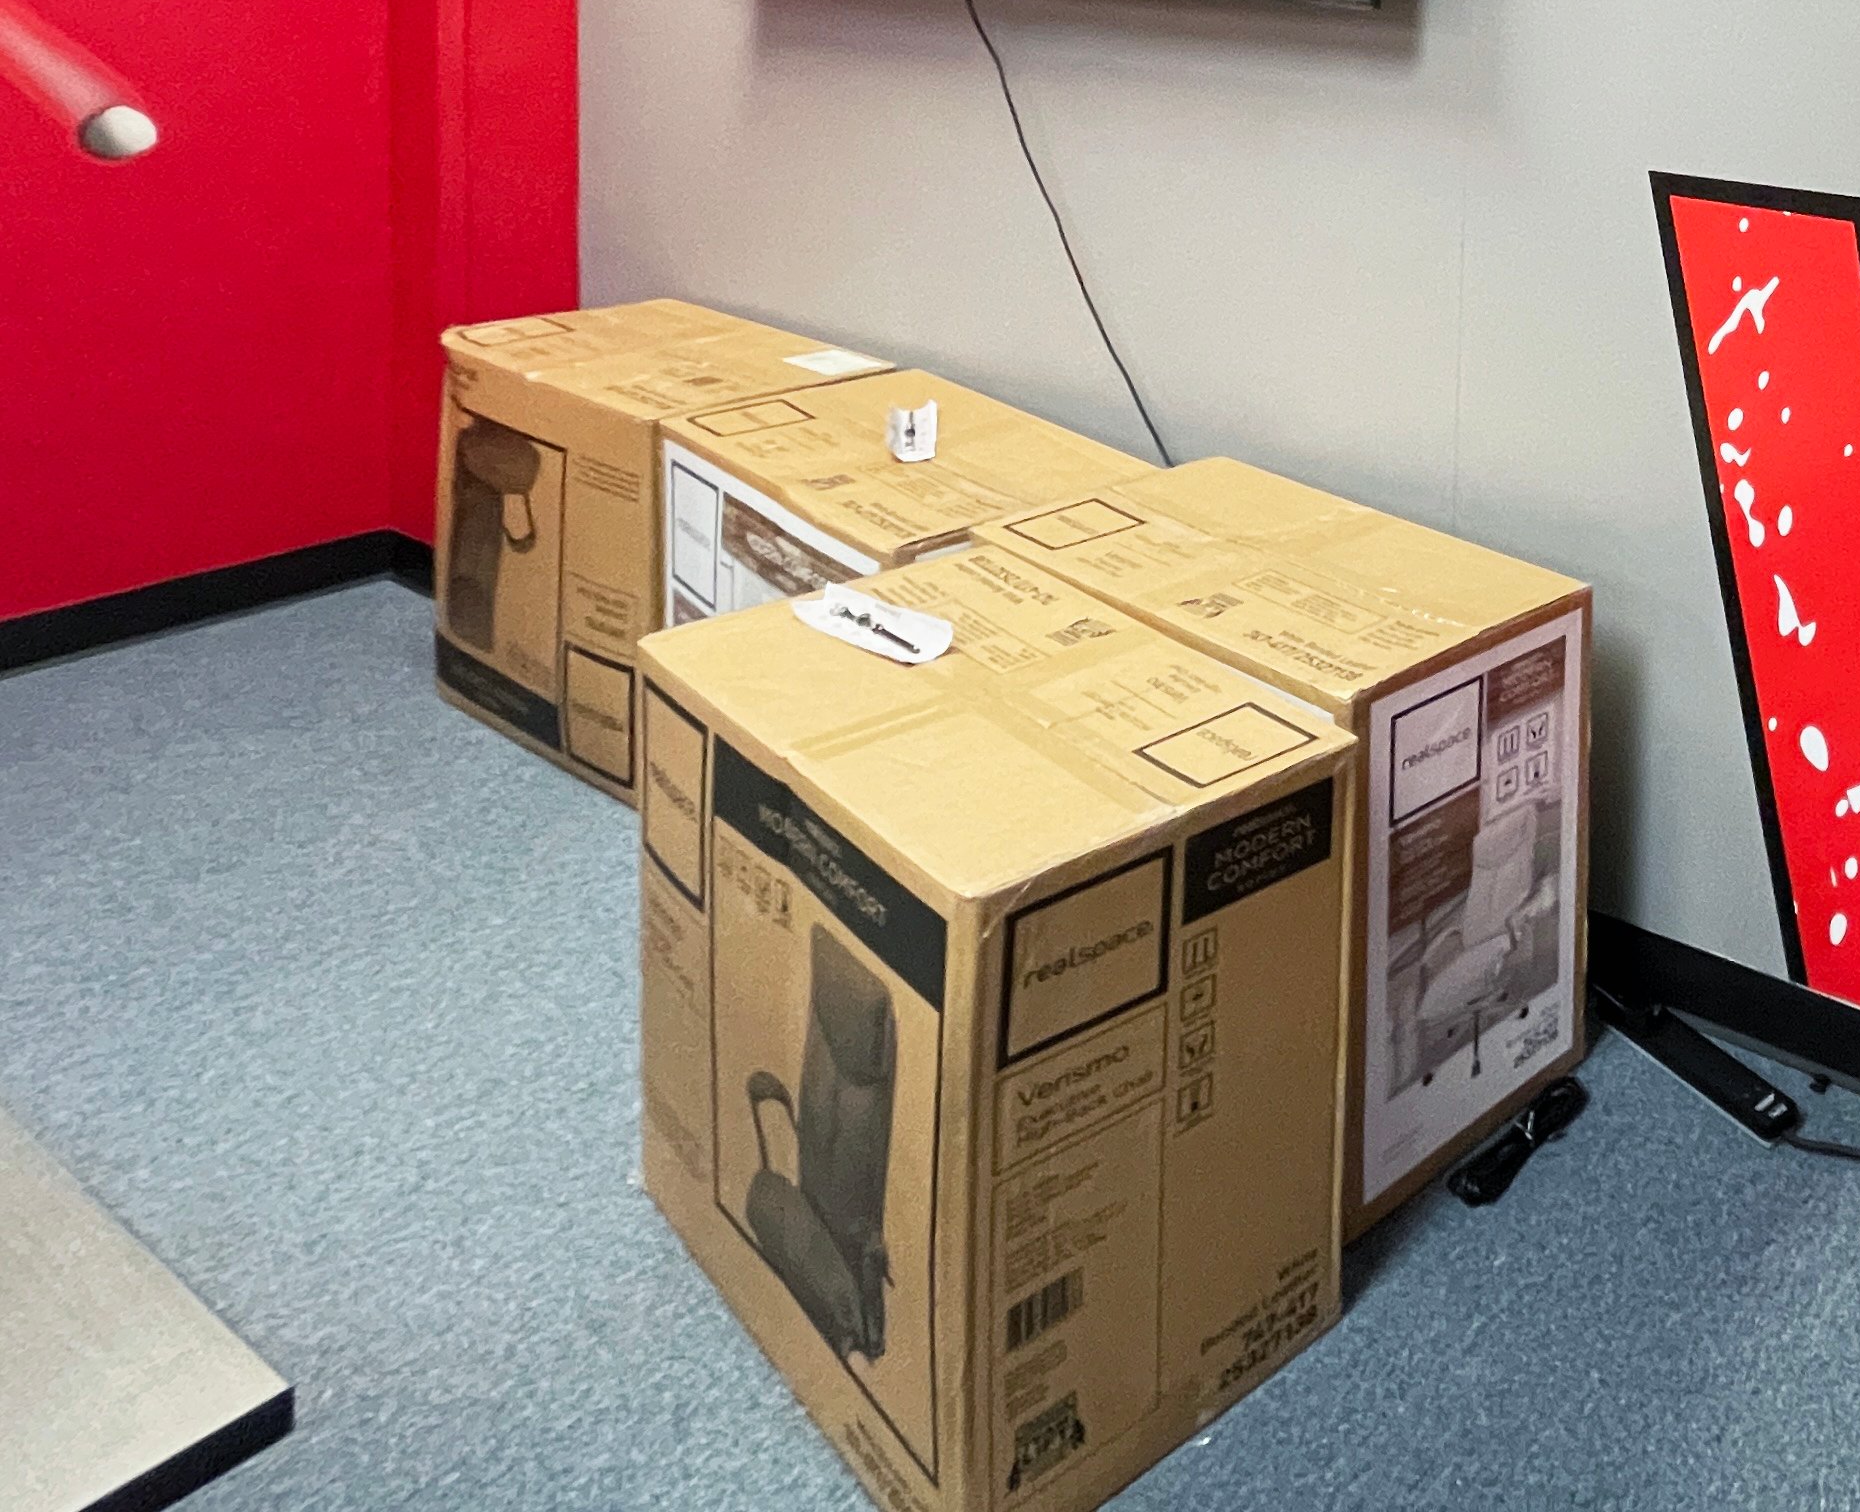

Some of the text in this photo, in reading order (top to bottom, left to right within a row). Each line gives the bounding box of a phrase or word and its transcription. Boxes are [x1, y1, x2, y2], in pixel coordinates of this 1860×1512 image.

[1206, 830, 1319, 892] COMFORT
[1213, 814, 1314, 870] MODERN
[1021, 919, 1153, 989] realspace
